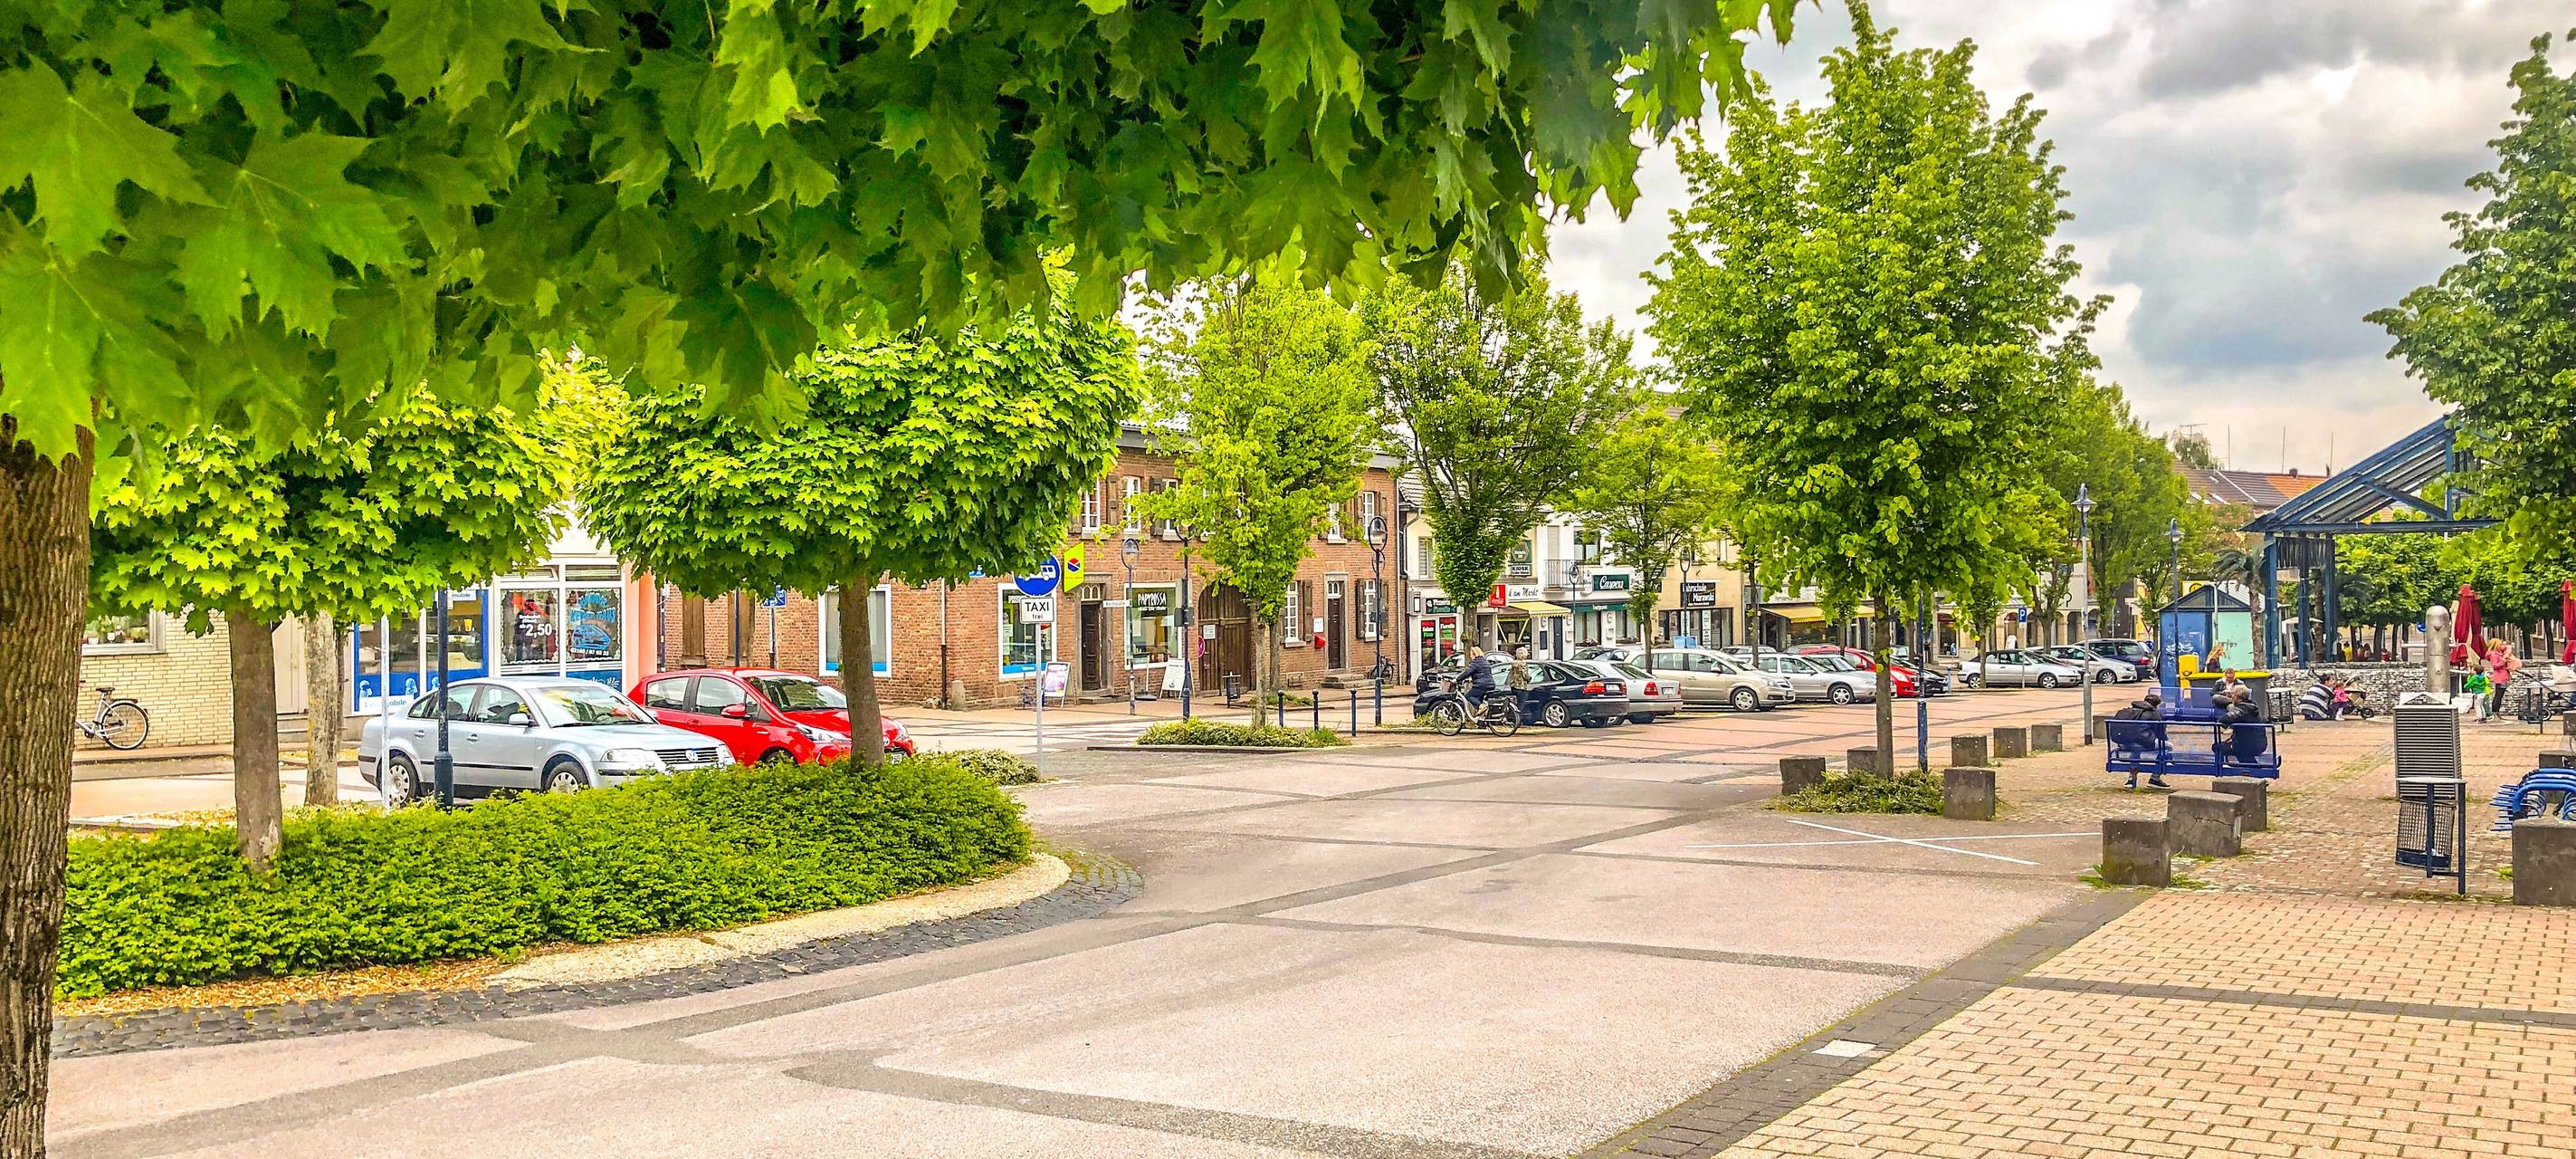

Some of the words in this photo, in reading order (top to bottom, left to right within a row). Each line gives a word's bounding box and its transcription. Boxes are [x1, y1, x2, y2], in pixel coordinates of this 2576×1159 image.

[1025, 602, 1049, 612] TAXI
[2019, 609, 2025, 620] P
[525, 623, 552, 638] 2,50
